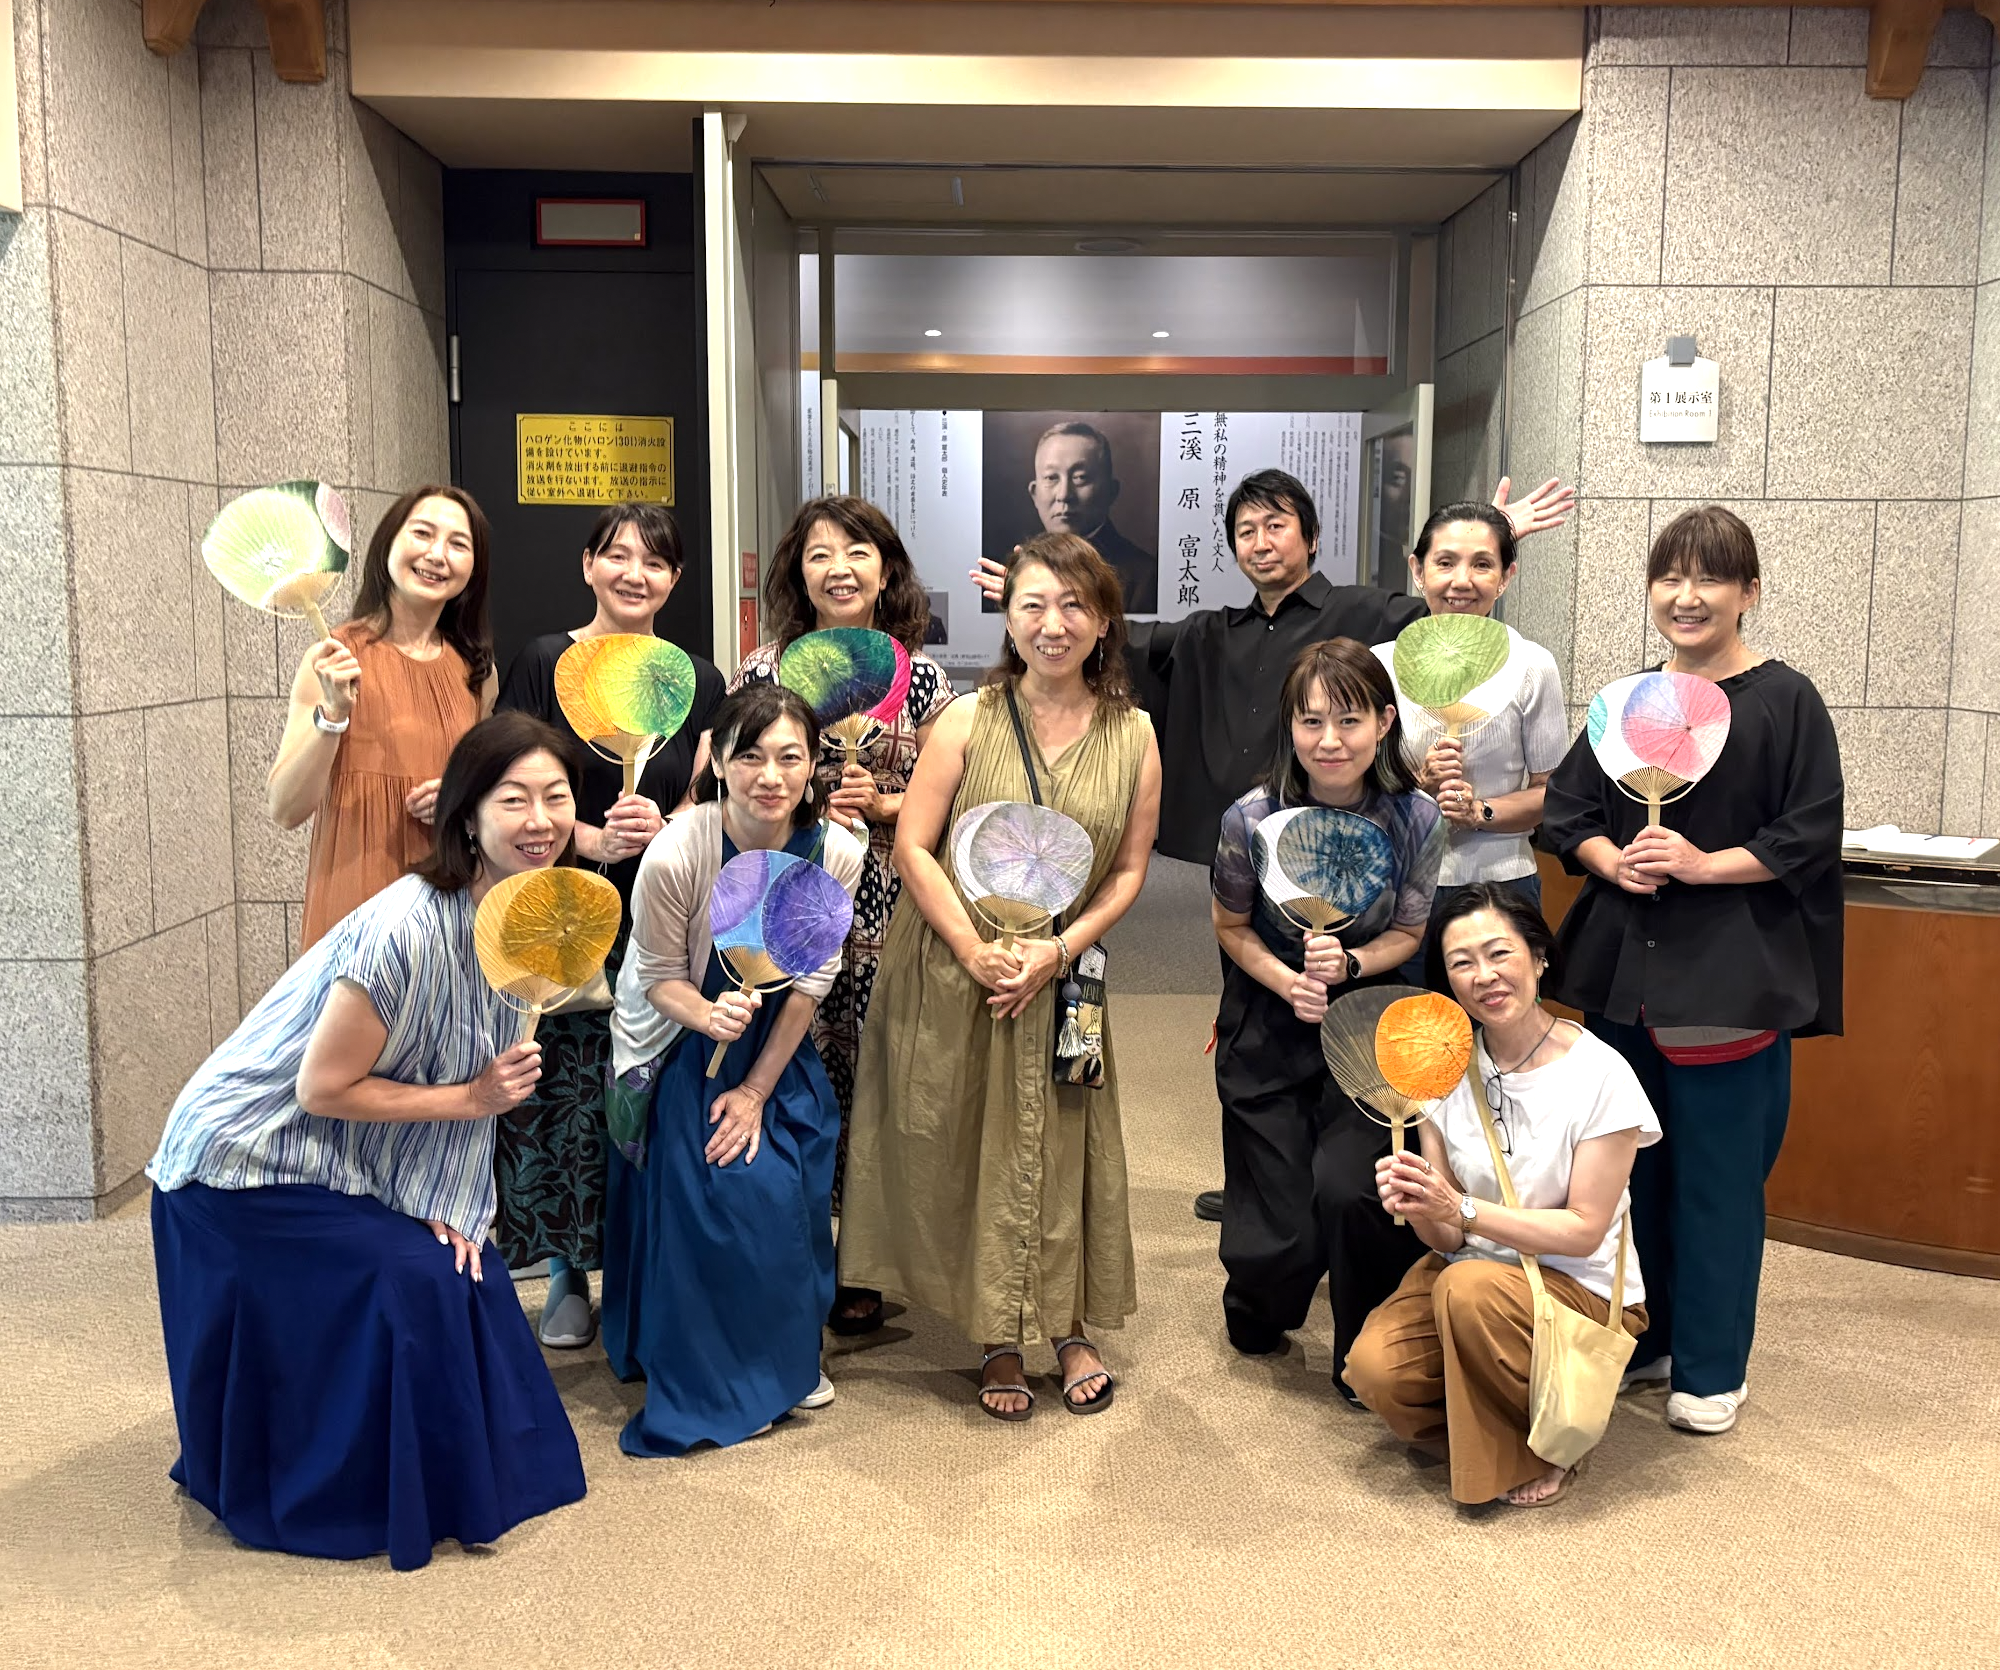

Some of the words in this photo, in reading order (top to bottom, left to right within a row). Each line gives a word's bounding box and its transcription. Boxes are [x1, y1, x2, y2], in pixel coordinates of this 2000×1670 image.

[1684, 409, 1706, 418] Room
[569, 422, 623, 432] ここには
[526, 448, 607, 459] 備を設けています。
[1177, 487, 1200, 510] 原
[1211, 412, 1228, 573] 無私の精神を貫いた文人
[1177, 534, 1201, 608] 富太郎
